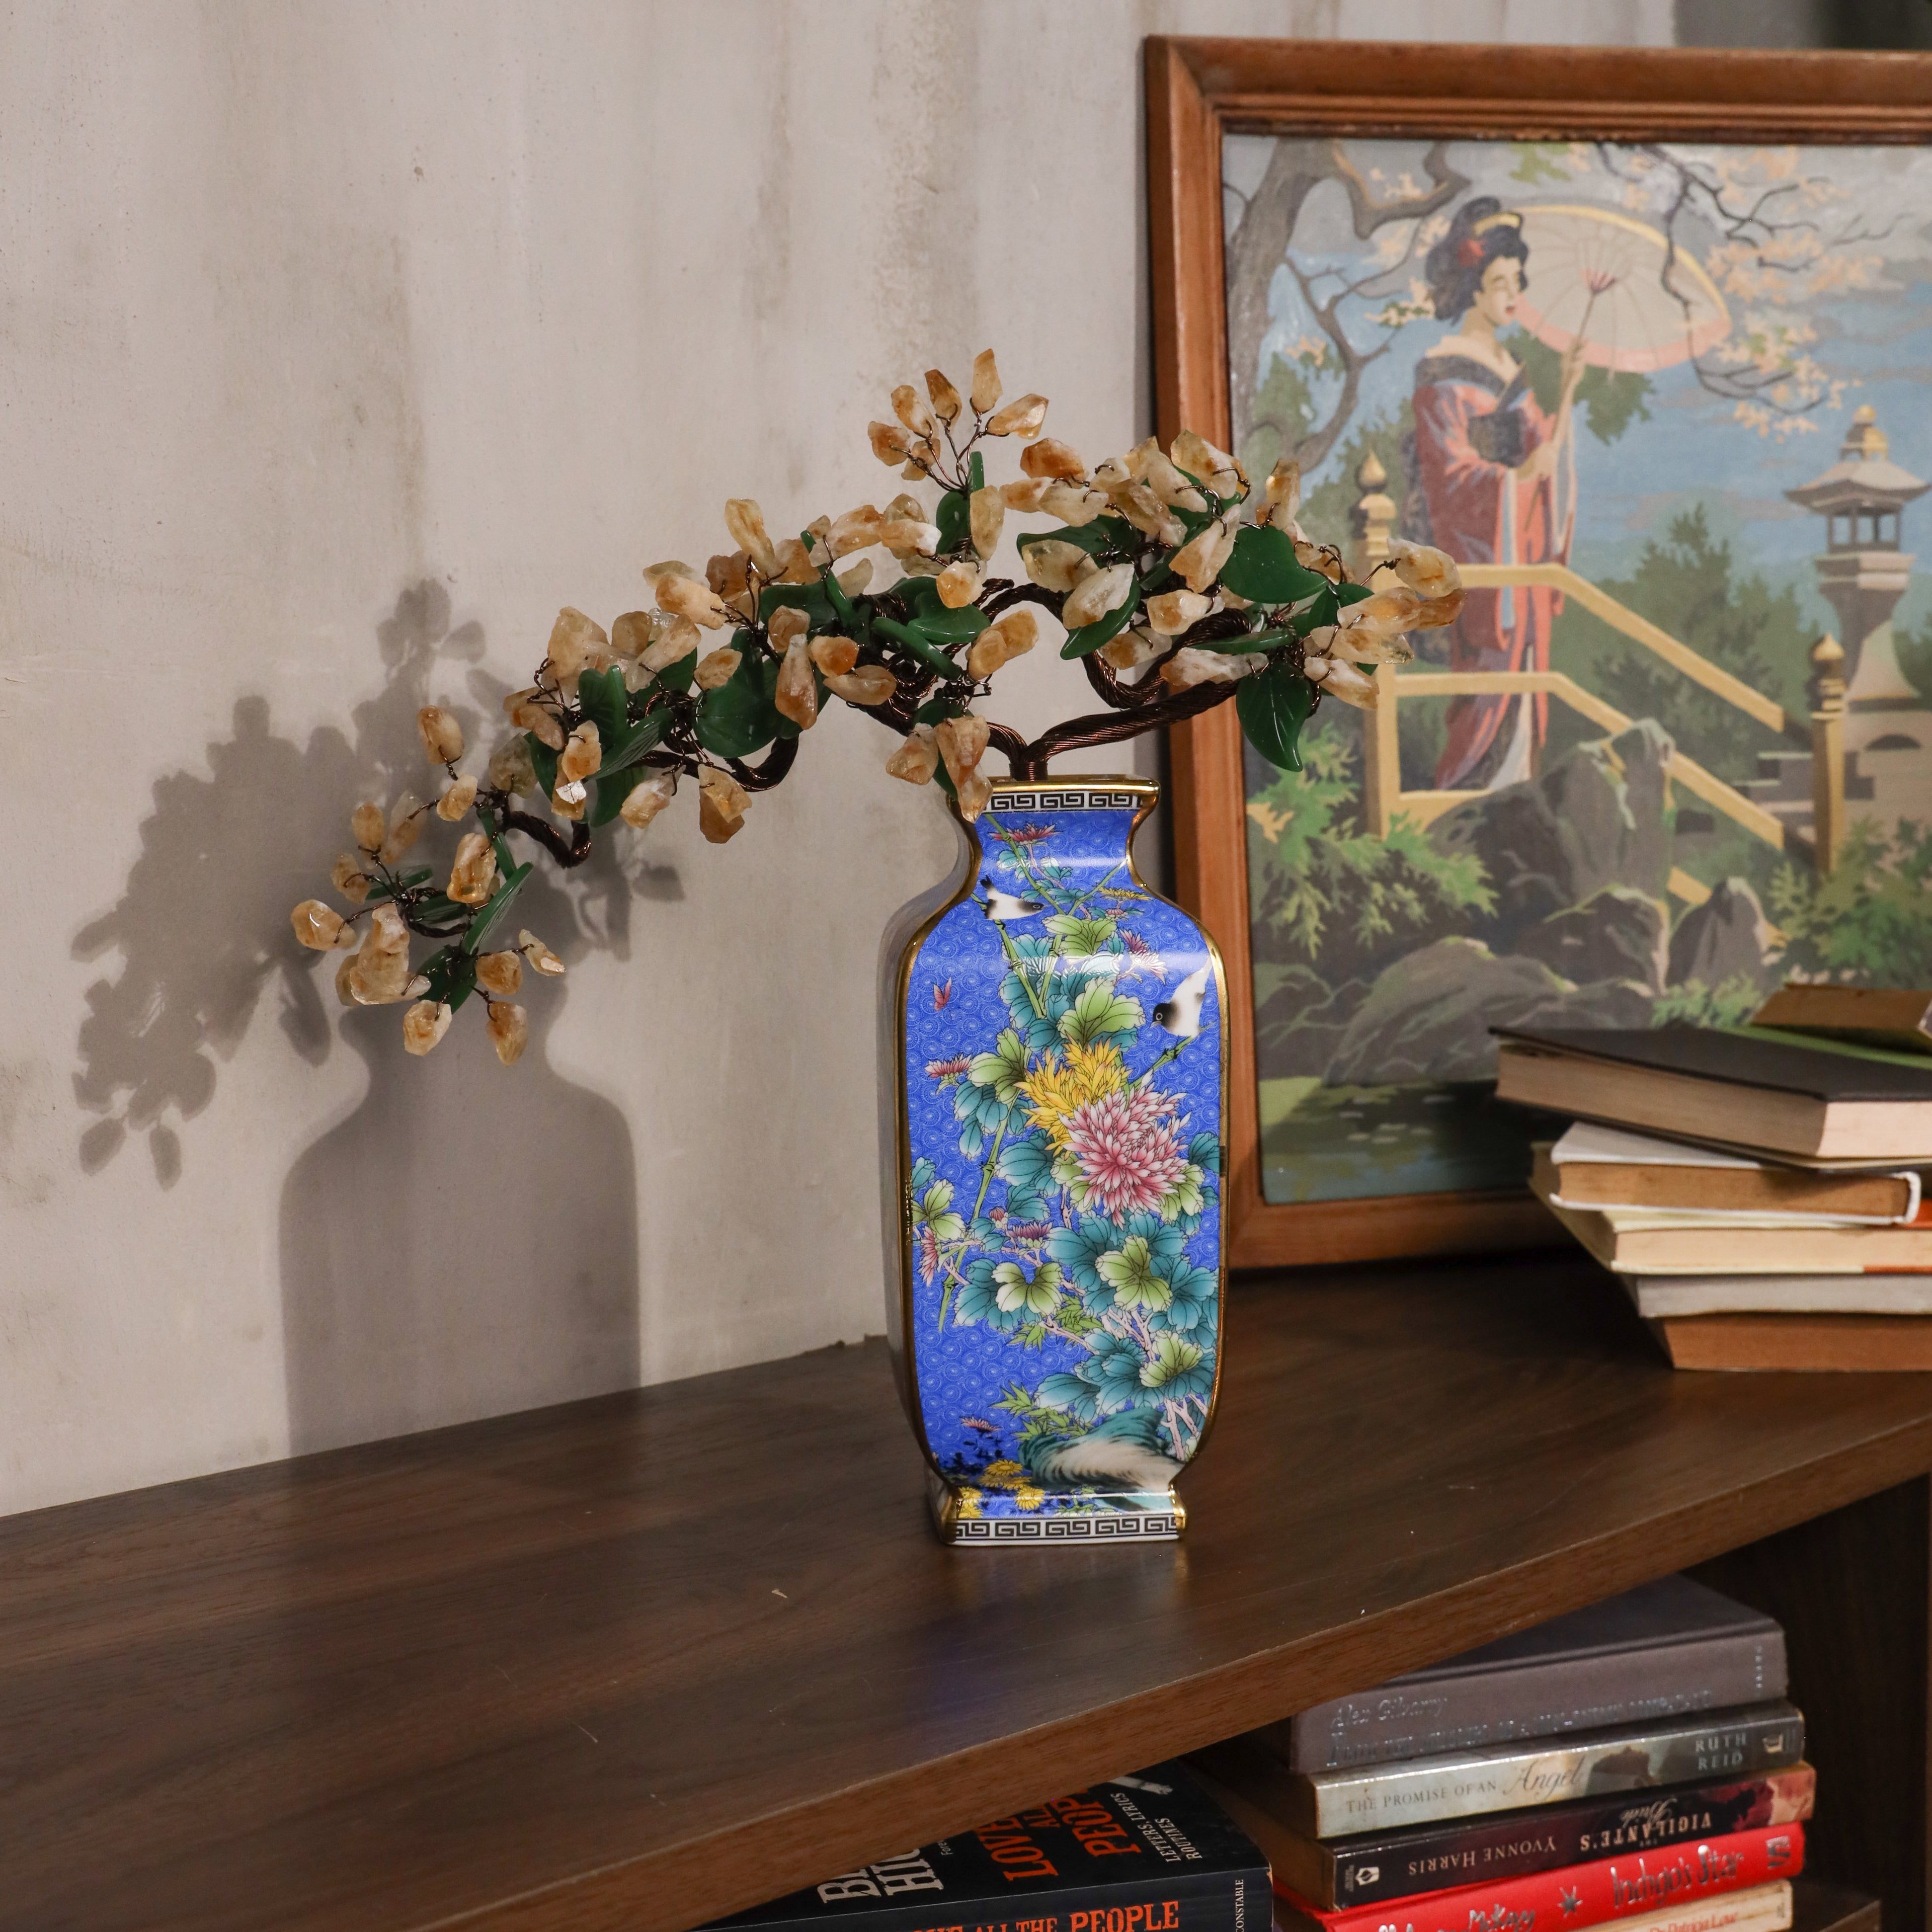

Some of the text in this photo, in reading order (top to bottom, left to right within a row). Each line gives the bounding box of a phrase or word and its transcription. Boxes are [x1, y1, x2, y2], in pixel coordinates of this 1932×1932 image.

[1695, 1732, 1746, 1752] RUTH
[1698, 1751, 1743, 1771] REID
[1346, 1754, 1586, 1814] THE PROMISE OF AN Angel
[937, 1839, 954, 1856] Fore
[1110, 1792, 1182, 1863] LETTERS, LYRICS
[1154, 1817, 1203, 1860] ROUTINES
[1580, 1811, 1712, 1852] VIGILANTE'S
[977, 1817, 1059, 1881] LOVE
[1408, 1835, 1558, 1876] YVONNE HARRIS
[1610, 1856, 1692, 1909] Indigo's
[1697, 1844, 1745, 1885] Star
[1070, 1901, 1179, 1932] PEOPLE
[1234, 1879, 1244, 1932] CONSTABLE
